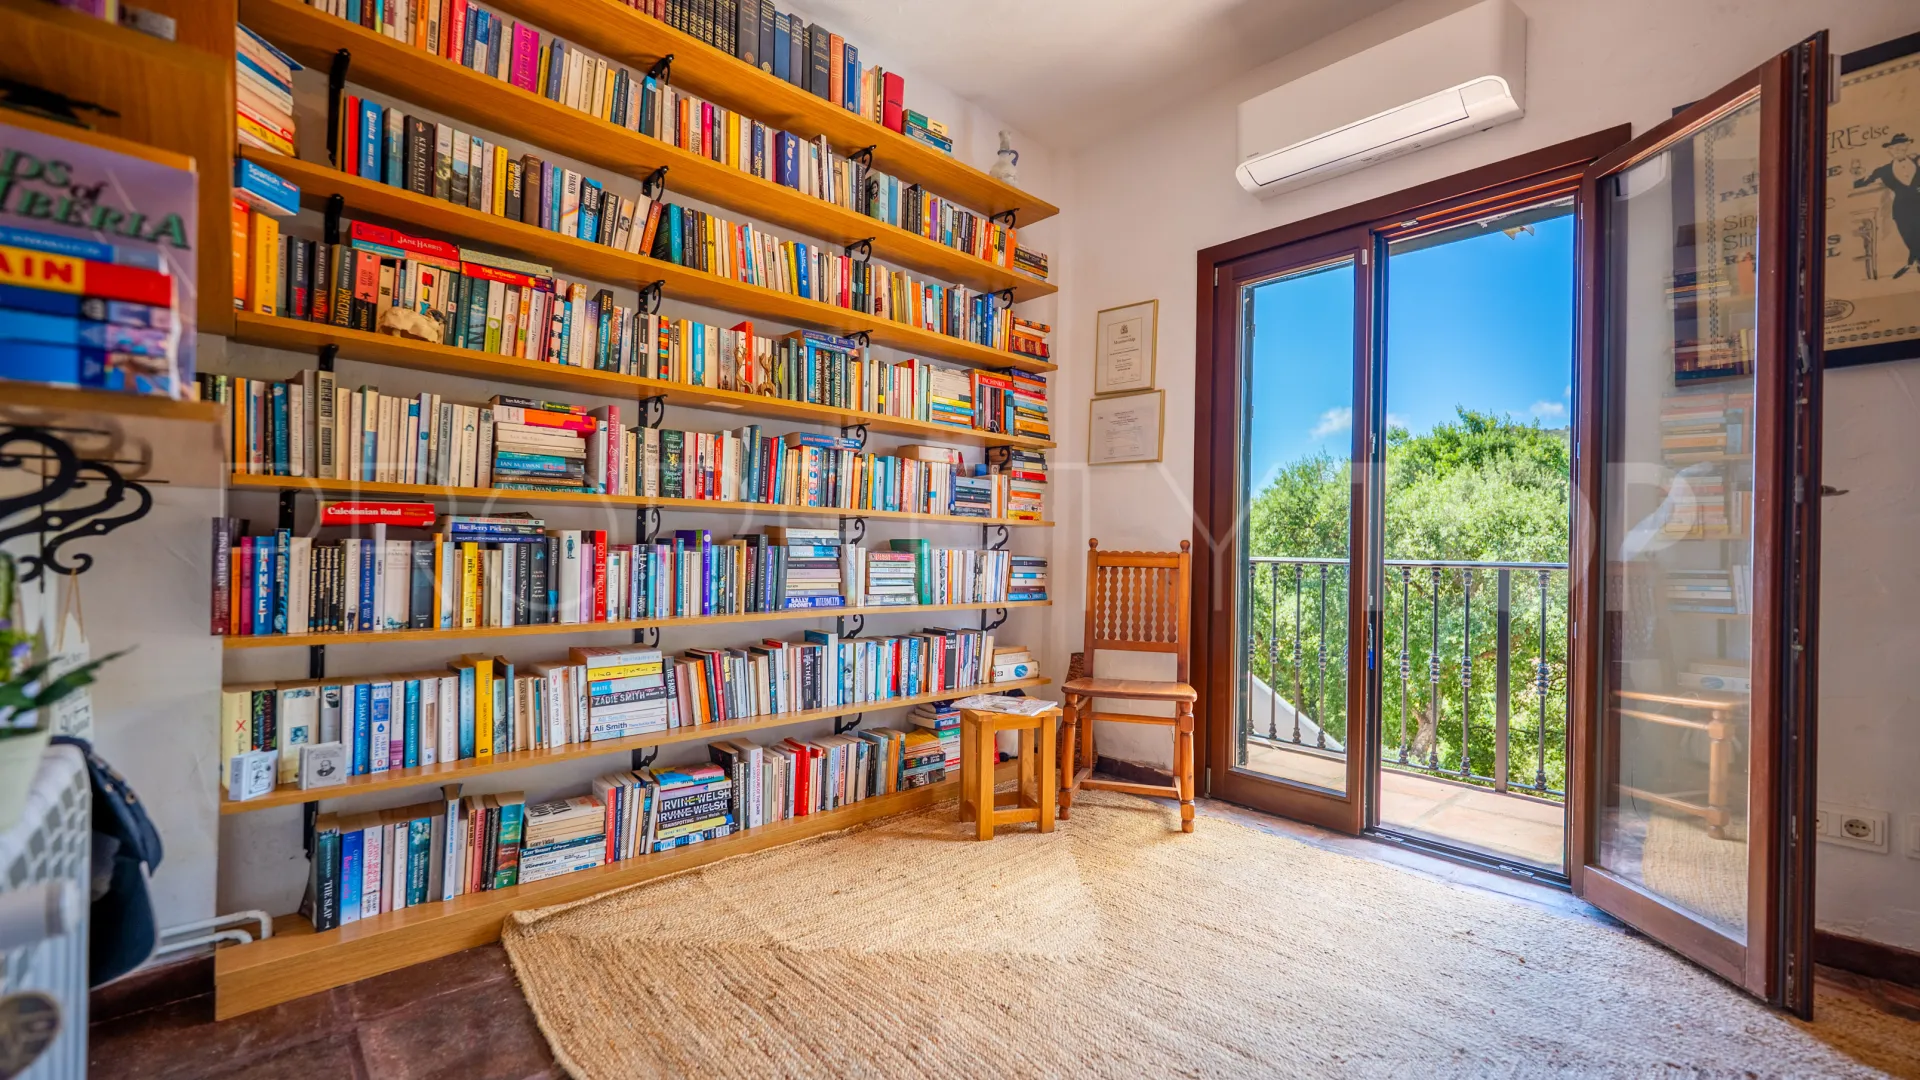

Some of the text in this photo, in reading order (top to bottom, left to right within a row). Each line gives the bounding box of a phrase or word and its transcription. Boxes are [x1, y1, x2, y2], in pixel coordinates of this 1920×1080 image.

[1862, 125, 1890, 141] else
[248, 163, 280, 187] Spanish
[417, 136, 426, 193] KEN FOLLETT
[513, 164, 521, 198] JOHN FOWLES
[568, 173, 577, 195] FRANZEN
[69, 181, 108, 204] of
[583, 209, 594, 240] FREEDOM
[296, 242, 304, 262] ROBERT
[397, 235, 443, 252] JANE HARRIS
[482, 267, 517, 280] THE WOMEN
[336, 251, 352, 325] ROBERT HARRIS PRECIPICE
[560, 309, 572, 362] NICK HORNBY
[981, 377, 1006, 387] PACHINKO
[327, 506, 402, 516] Caledonian Road
[470, 525, 488, 533] Berry
[217, 531, 228, 586] EDNA O'BRIEN
[596, 542, 604, 605] JODI PICOULT
[259, 547, 270, 624] HAMNET
[667, 668, 677, 696] THE FARM
[358, 688, 368, 731] ELIF SHAFAK
[594, 691, 646, 706] ZADIE SMITH
[594, 724, 604, 732] Ali
[605, 721, 628, 730] Smith
[657, 800, 728, 822] IRVINE WELSH
[661, 796, 697, 812] IRVINE
[697, 788, 732, 803] WELSH
[662, 818, 694, 828] TRAINSPOTTING
[654, 833, 697, 850] IRVINE WELSH
[324, 879, 336, 897] THE
[323, 899, 335, 919] SLAP
